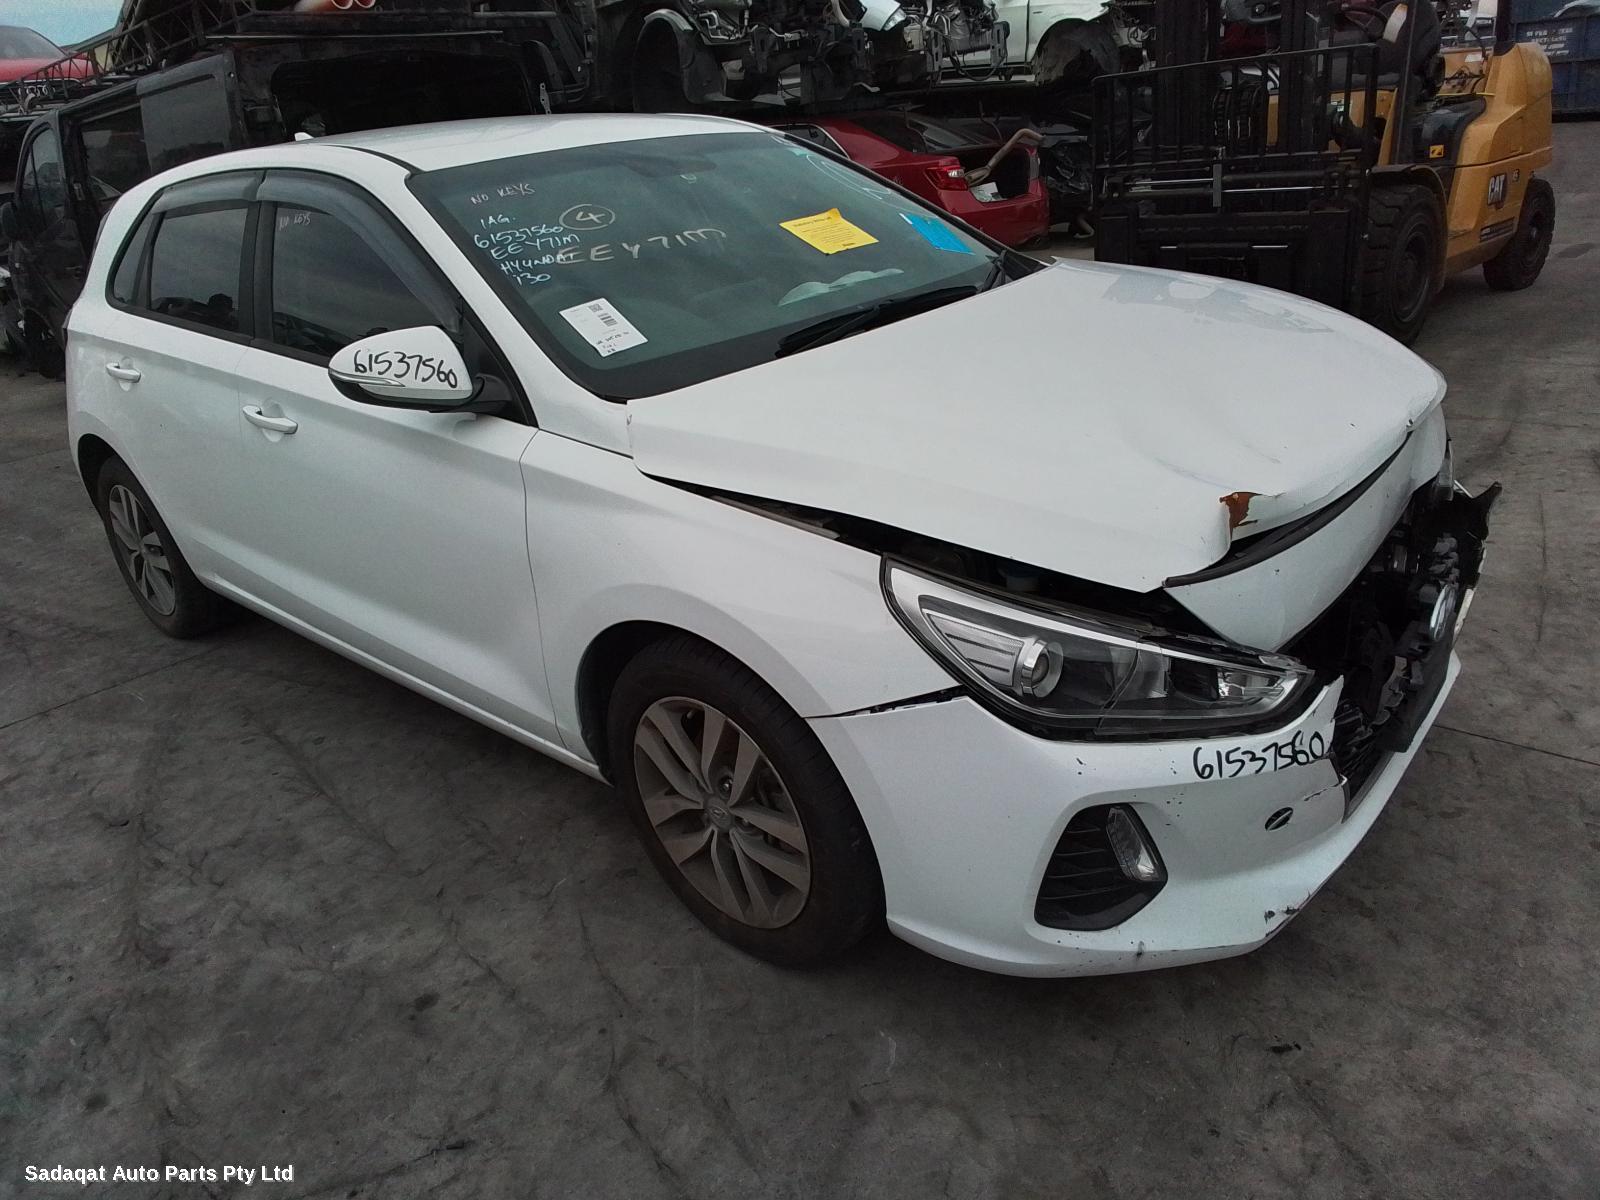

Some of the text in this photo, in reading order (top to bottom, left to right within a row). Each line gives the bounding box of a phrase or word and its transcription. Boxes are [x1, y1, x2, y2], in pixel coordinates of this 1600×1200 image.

[470, 182, 537, 205] NO KEYS
[1487, 174, 1506, 205] CAT
[575, 210, 606, 225] 4
[473, 223, 565, 250] 61537560
[353, 349, 458, 389] 61537560
[1193, 730, 1325, 780] 61537560
